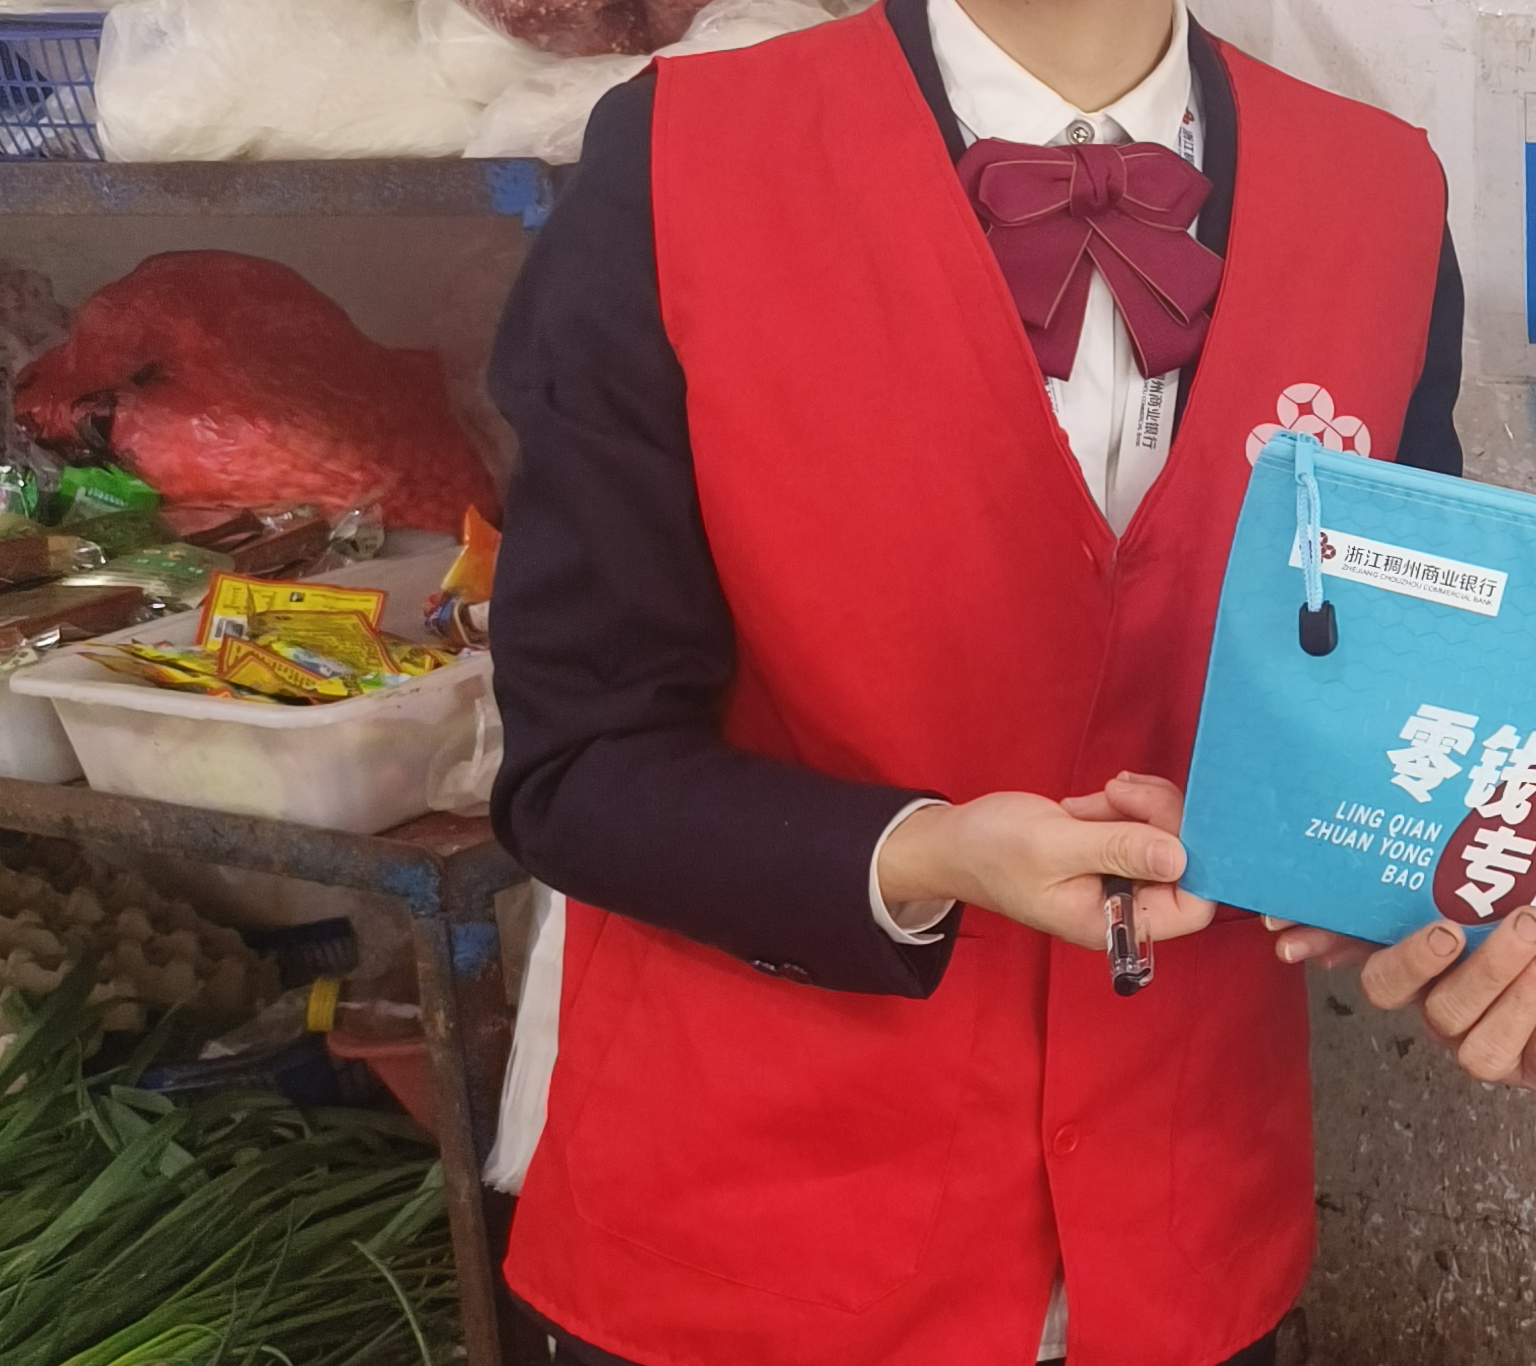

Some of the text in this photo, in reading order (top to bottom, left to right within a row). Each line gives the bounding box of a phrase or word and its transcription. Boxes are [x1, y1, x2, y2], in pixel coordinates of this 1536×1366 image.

[1341, 563, 1379, 579] ZHEJIANG
[1344, 545, 1499, 598] 浙江稠州商业银行
[1304, 818, 1434, 868] ZHUAN YONG
[1334, 800, 1443, 843] LING QIAN
[1380, 864, 1426, 893] BAO
